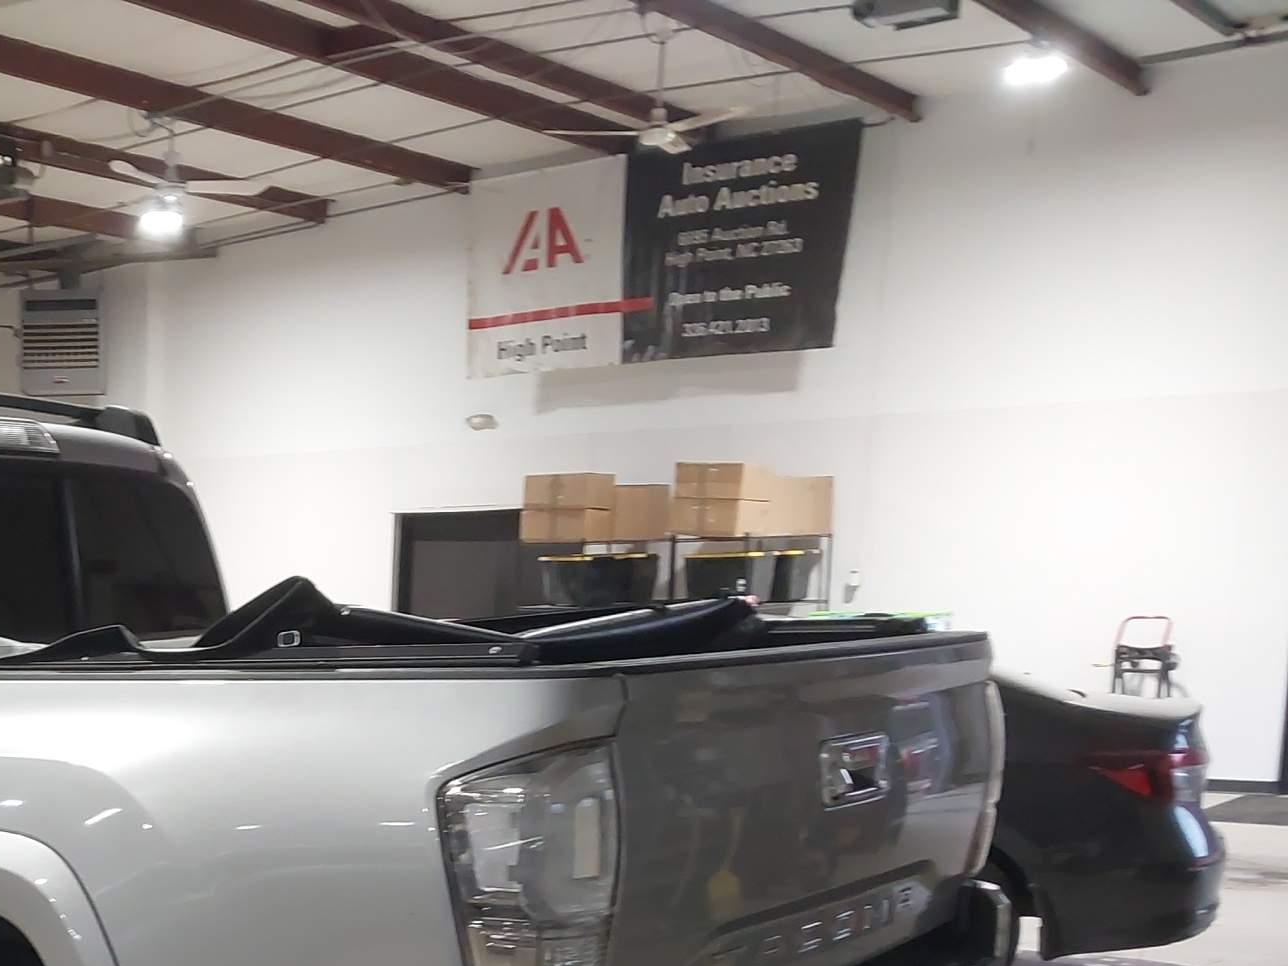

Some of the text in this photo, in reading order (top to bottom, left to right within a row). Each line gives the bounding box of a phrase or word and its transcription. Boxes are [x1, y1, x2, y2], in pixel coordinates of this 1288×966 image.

[682, 153, 798, 185] Insurance
[657, 181, 820, 218] Auto Auctions
[719, 286, 742, 301] the
[744, 282, 792, 299] Public
[497, 333, 587, 361] High Point
